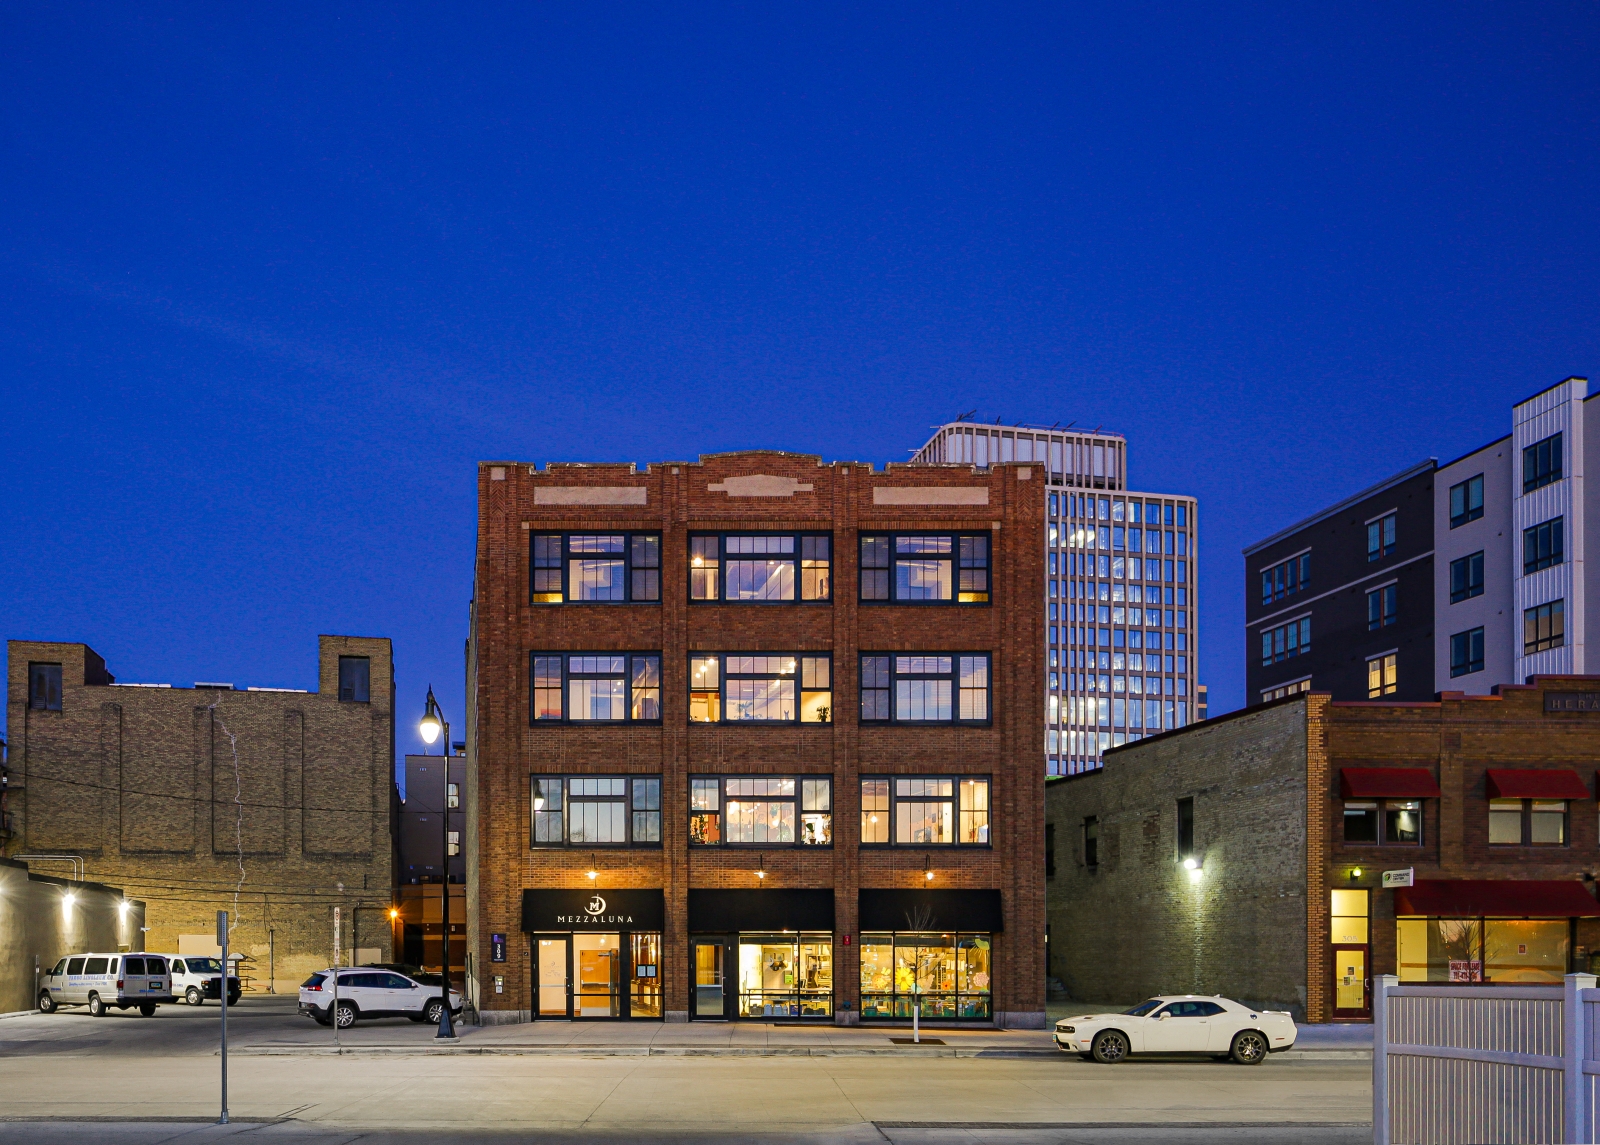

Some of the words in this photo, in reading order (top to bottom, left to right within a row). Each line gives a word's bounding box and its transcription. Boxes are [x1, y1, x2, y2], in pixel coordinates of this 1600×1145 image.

[1552, 699, 1599, 709] HERA
[557, 915, 633, 923] MEZZALUNA
[1342, 935, 1358, 943] 305
